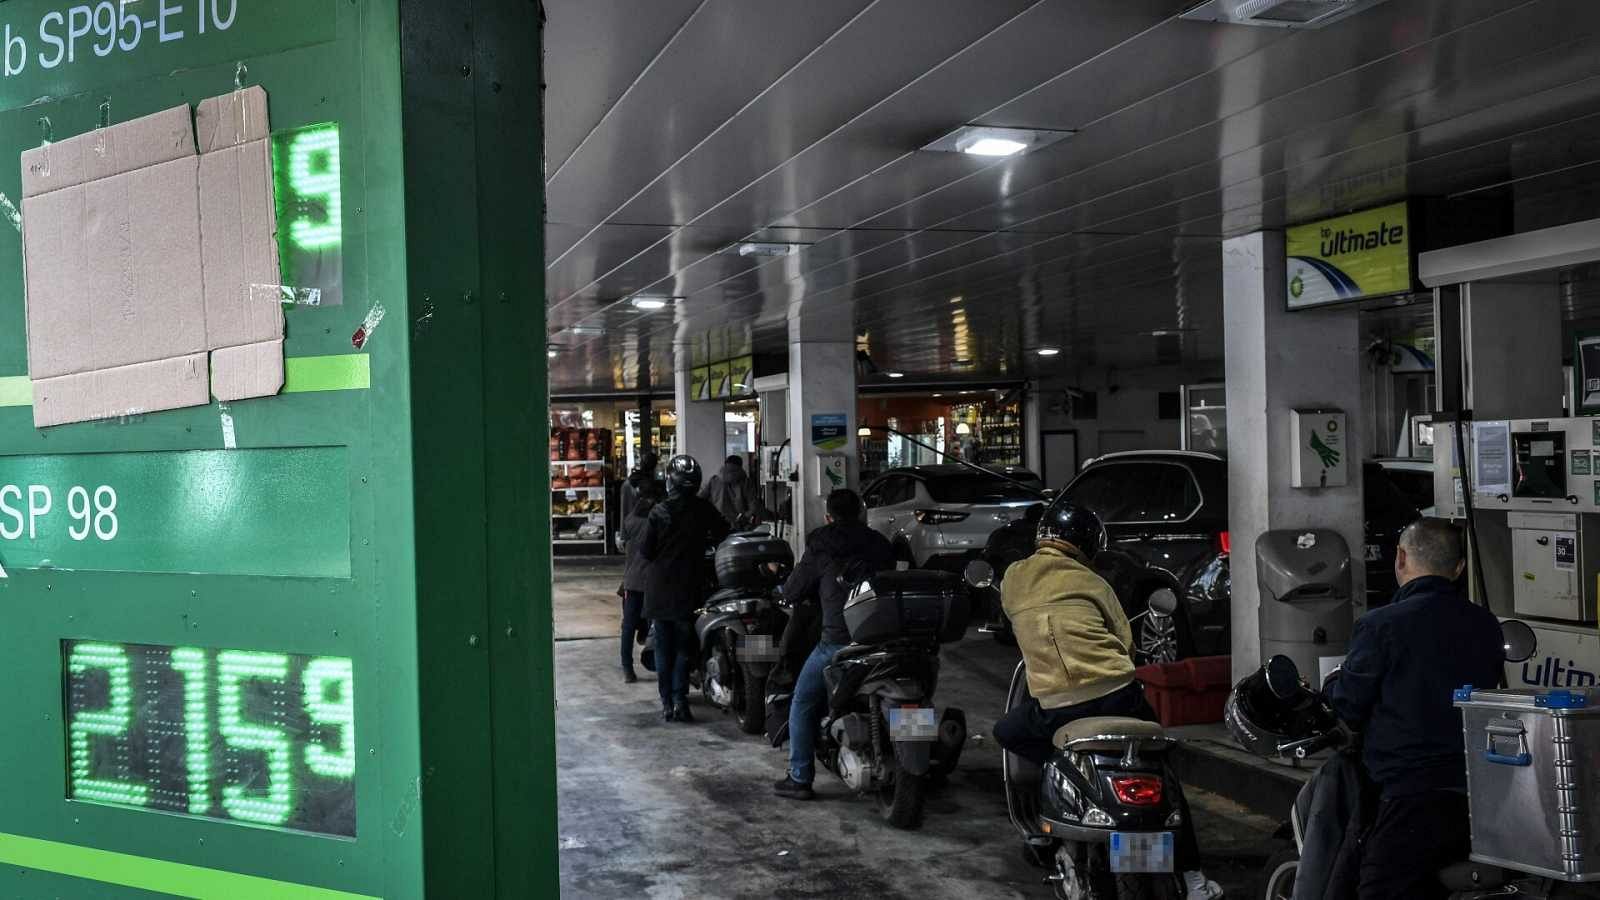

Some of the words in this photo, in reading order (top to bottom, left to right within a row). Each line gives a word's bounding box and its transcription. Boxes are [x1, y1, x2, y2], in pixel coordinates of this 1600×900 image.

[1320, 221, 1403, 257] ultimate
[0, 484, 52, 540] SP
[67, 485, 118, 541] 98
[1522, 656, 1600, 688] ultim
